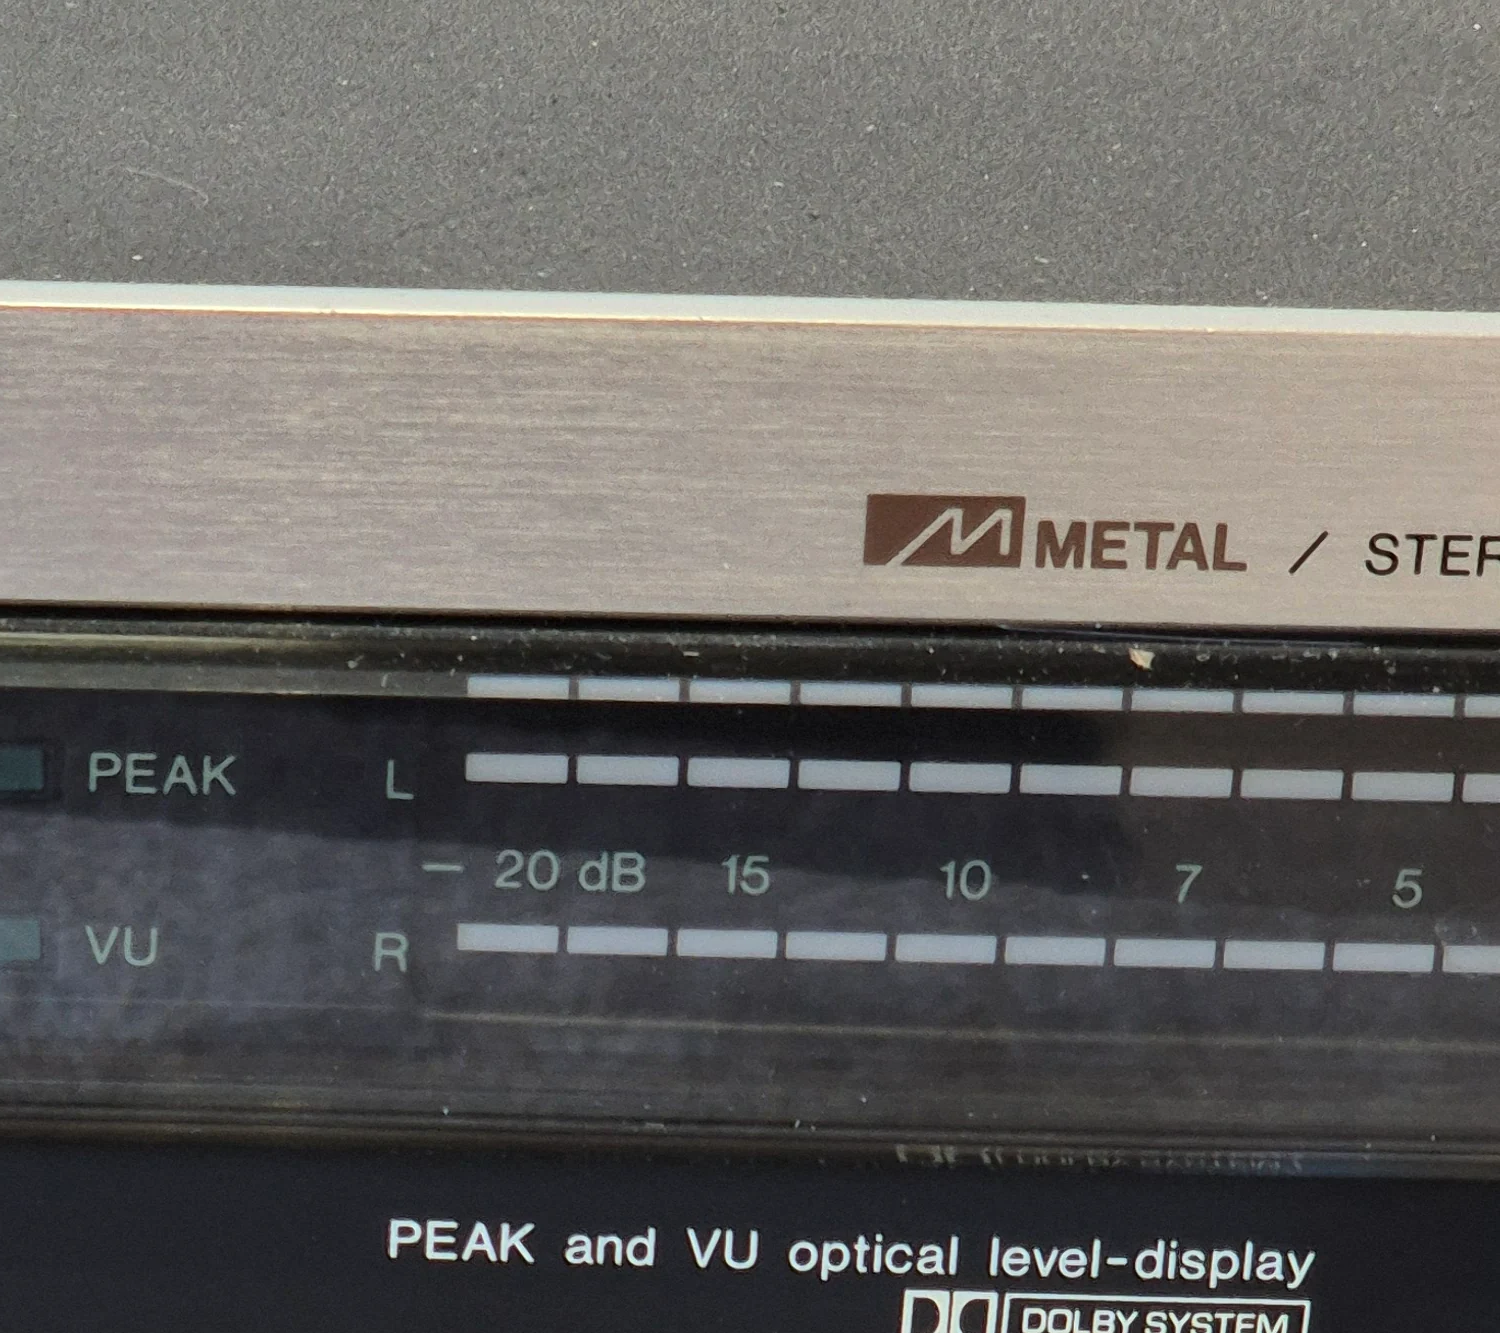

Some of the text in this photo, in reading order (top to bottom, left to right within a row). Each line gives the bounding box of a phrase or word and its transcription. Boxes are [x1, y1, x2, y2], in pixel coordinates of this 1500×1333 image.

[1035, 519, 1248, 572] METAL
[1364, 532, 1500, 576] STER
[88, 752, 238, 797] PEAK
[386, 760, 414, 800] L
[578, 852, 648, 894] dB
[722, 855, 772, 896] 15
[940, 859, 993, 901] 10
[1174, 865, 1202, 904] 7
[1391, 868, 1423, 909] 5
[84, 925, 159, 967] VU
[374, 933, 408, 972] R
[387, 1219, 1317, 1289] PEAK and VU optical level-display
